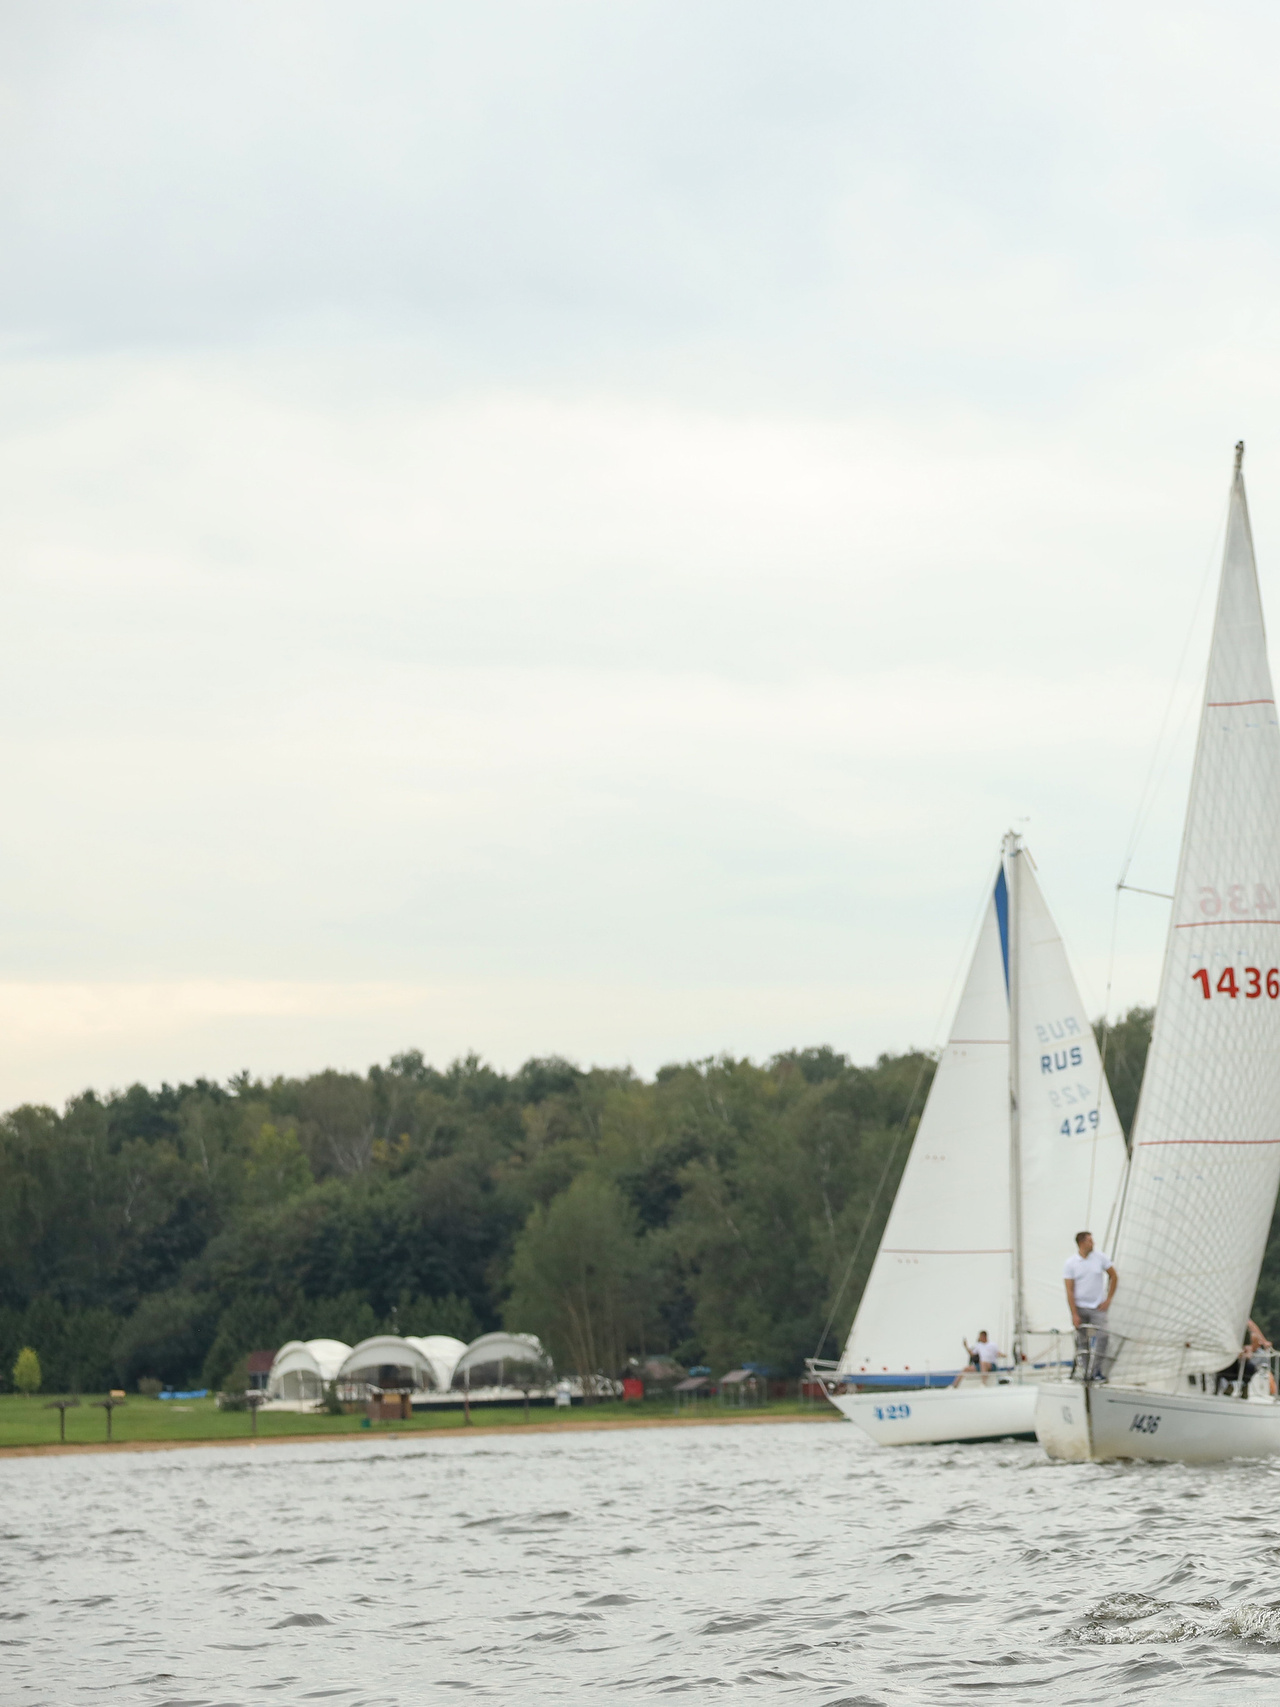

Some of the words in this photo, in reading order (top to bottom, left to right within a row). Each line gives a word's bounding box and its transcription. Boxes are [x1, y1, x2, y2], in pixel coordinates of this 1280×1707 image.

[1191, 966, 1280, 1000] 1436
[1041, 1046, 1082, 1074] RUS
[1060, 1109, 1099, 1137] 429
[1129, 1413, 1161, 1434] 1436
